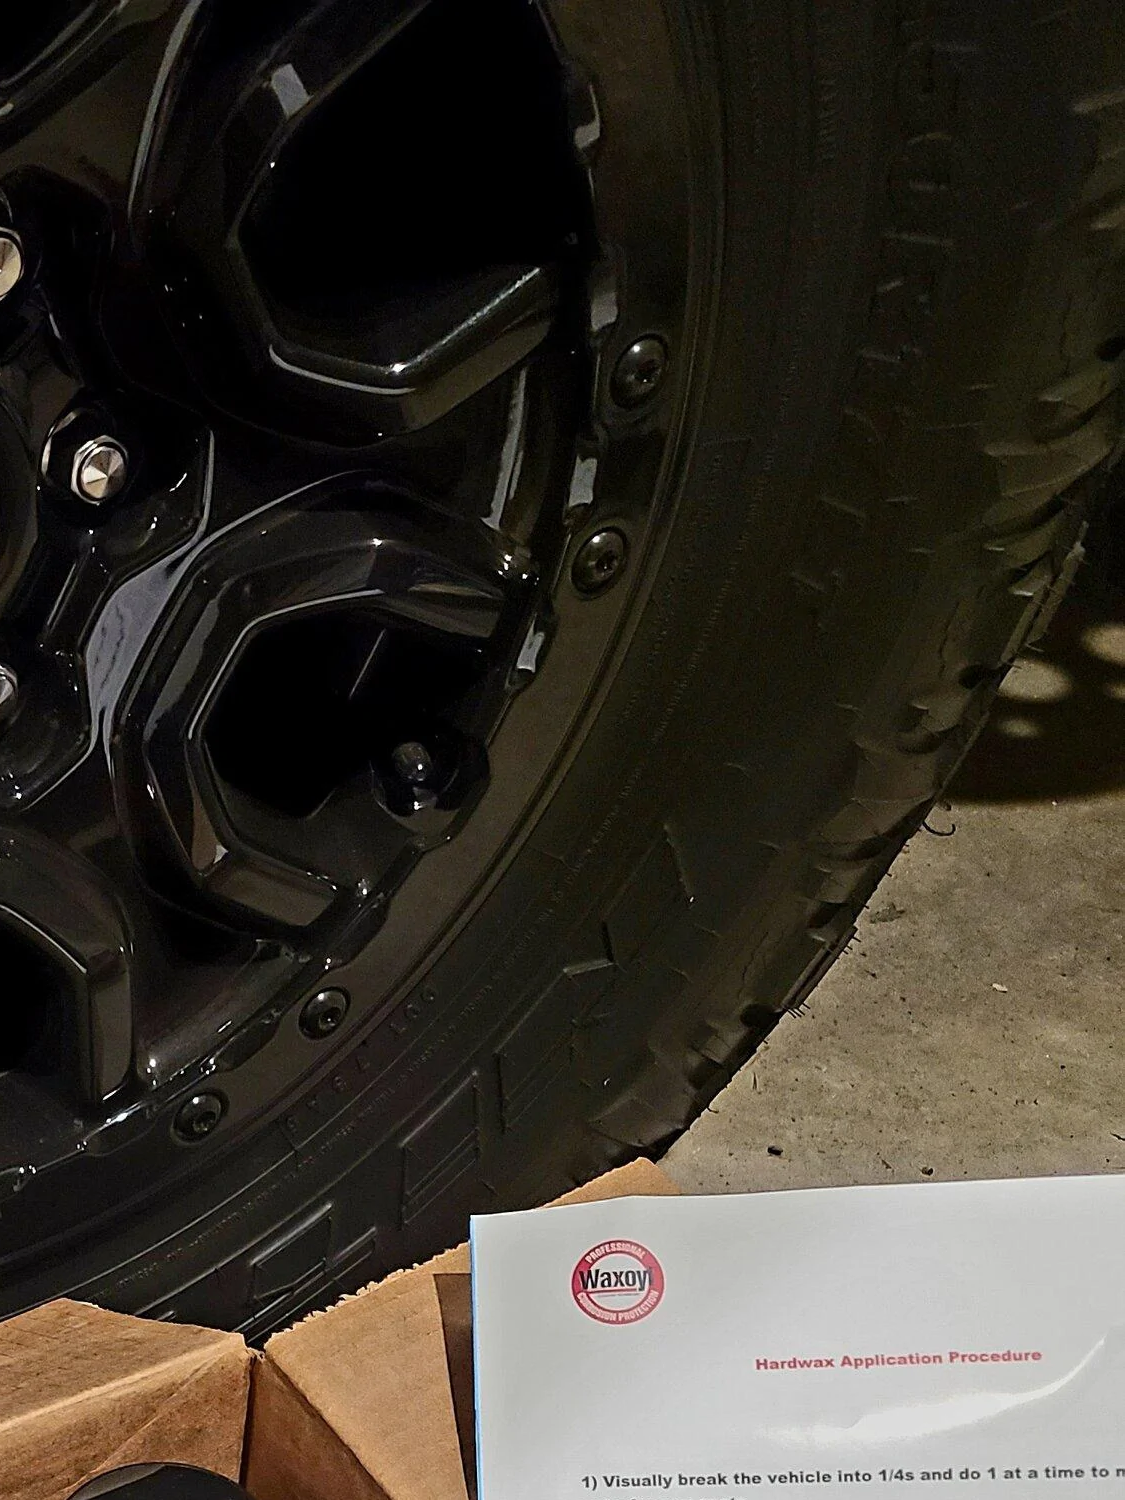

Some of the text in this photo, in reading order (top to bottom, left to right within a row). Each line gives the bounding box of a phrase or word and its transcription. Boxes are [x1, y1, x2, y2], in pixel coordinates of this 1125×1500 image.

[585, 1242, 646, 1263] PROFESSIONAL
[579, 1266, 653, 1292] Waxoyl
[618, 1290, 659, 1321] PROTECTION
[755, 1349, 1043, 1371] Hardwax Application Procedure
[581, 1466, 1110, 1492] 1) Visually break the vehicle into 1/4s and do 1 at a time to
